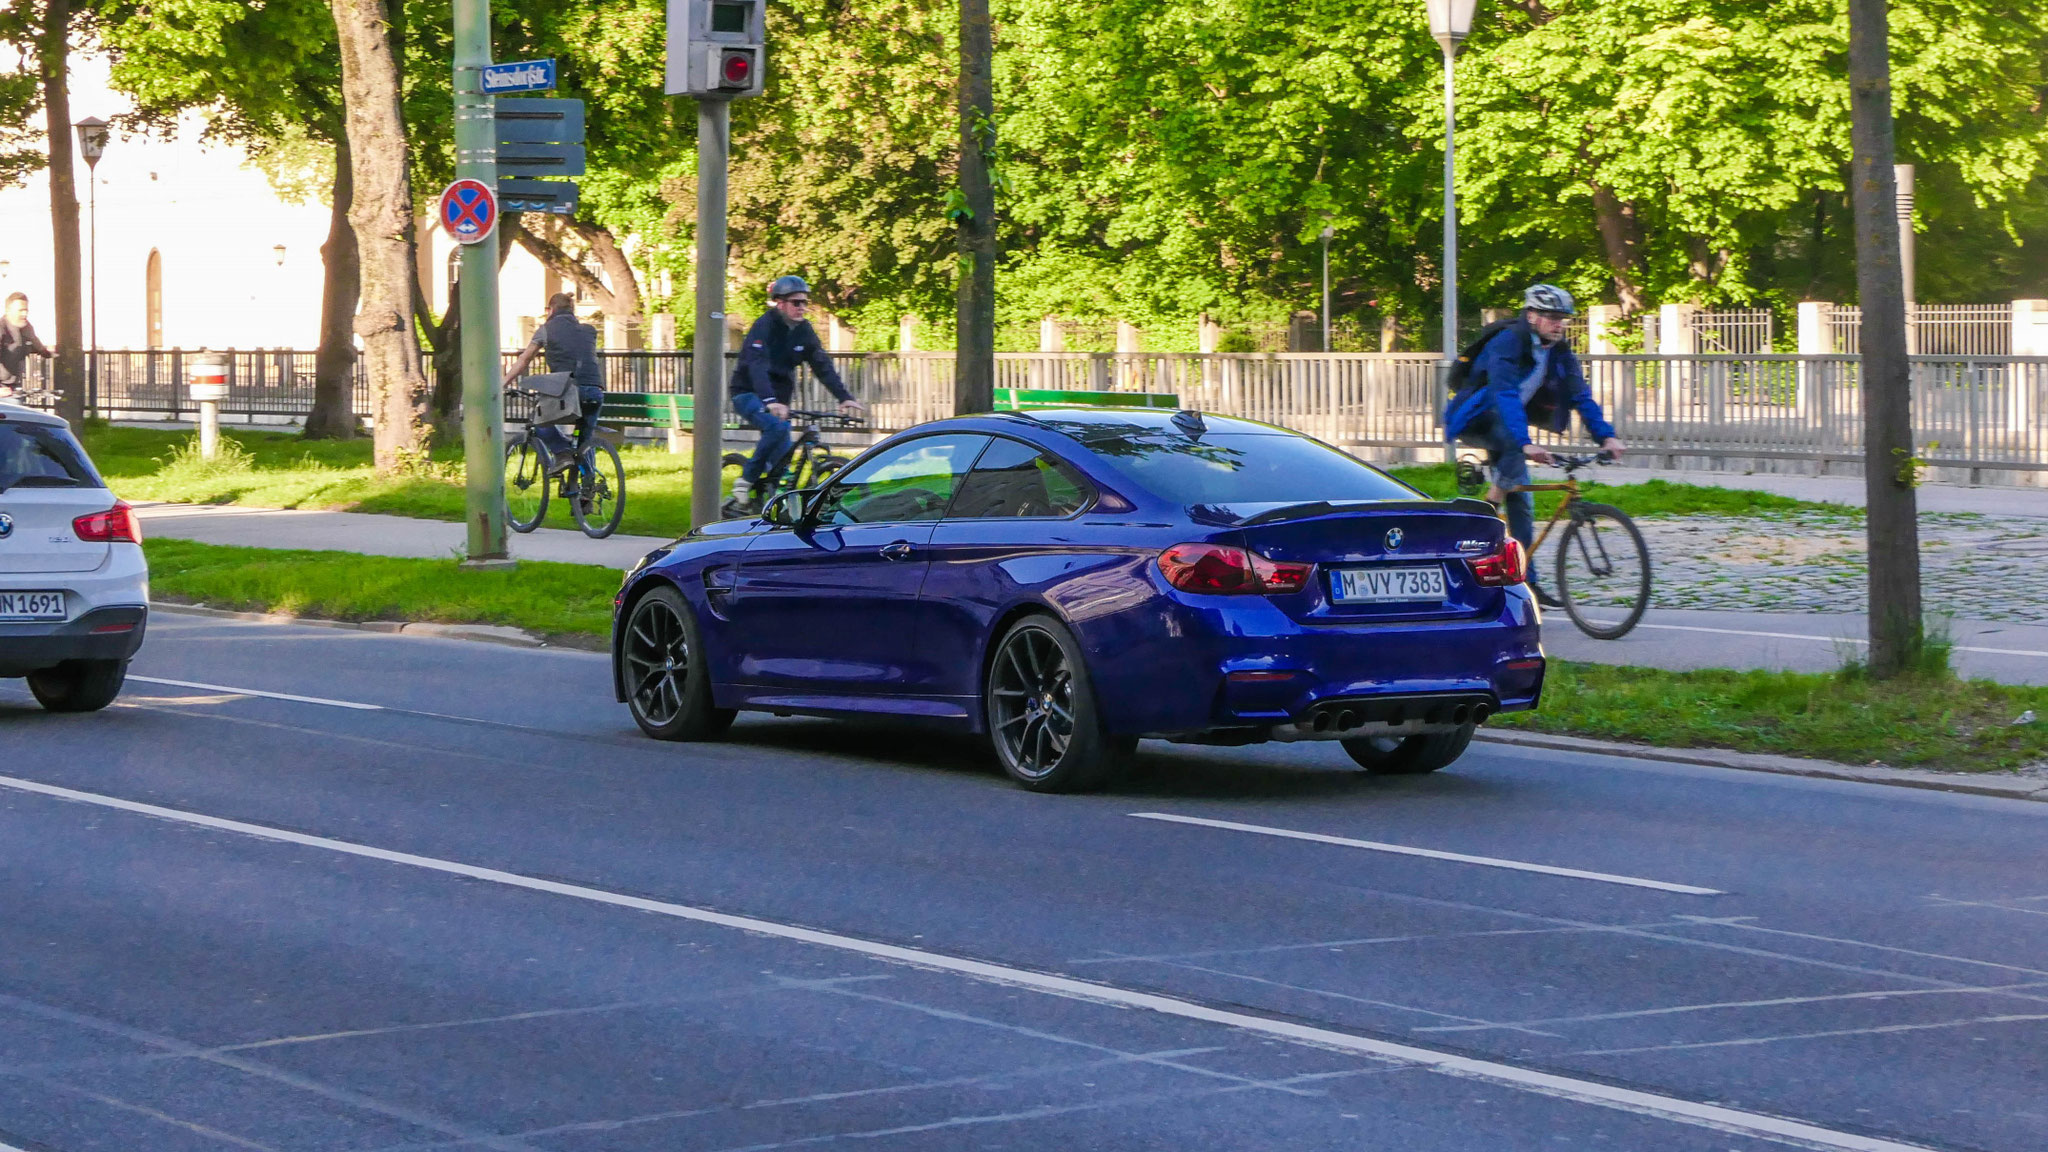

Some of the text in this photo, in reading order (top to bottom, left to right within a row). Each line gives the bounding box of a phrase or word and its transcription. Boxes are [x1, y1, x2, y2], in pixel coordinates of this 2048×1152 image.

[1343, 571, 1442, 595] M VY 7383
[0, 595, 62, 613] N 1691
